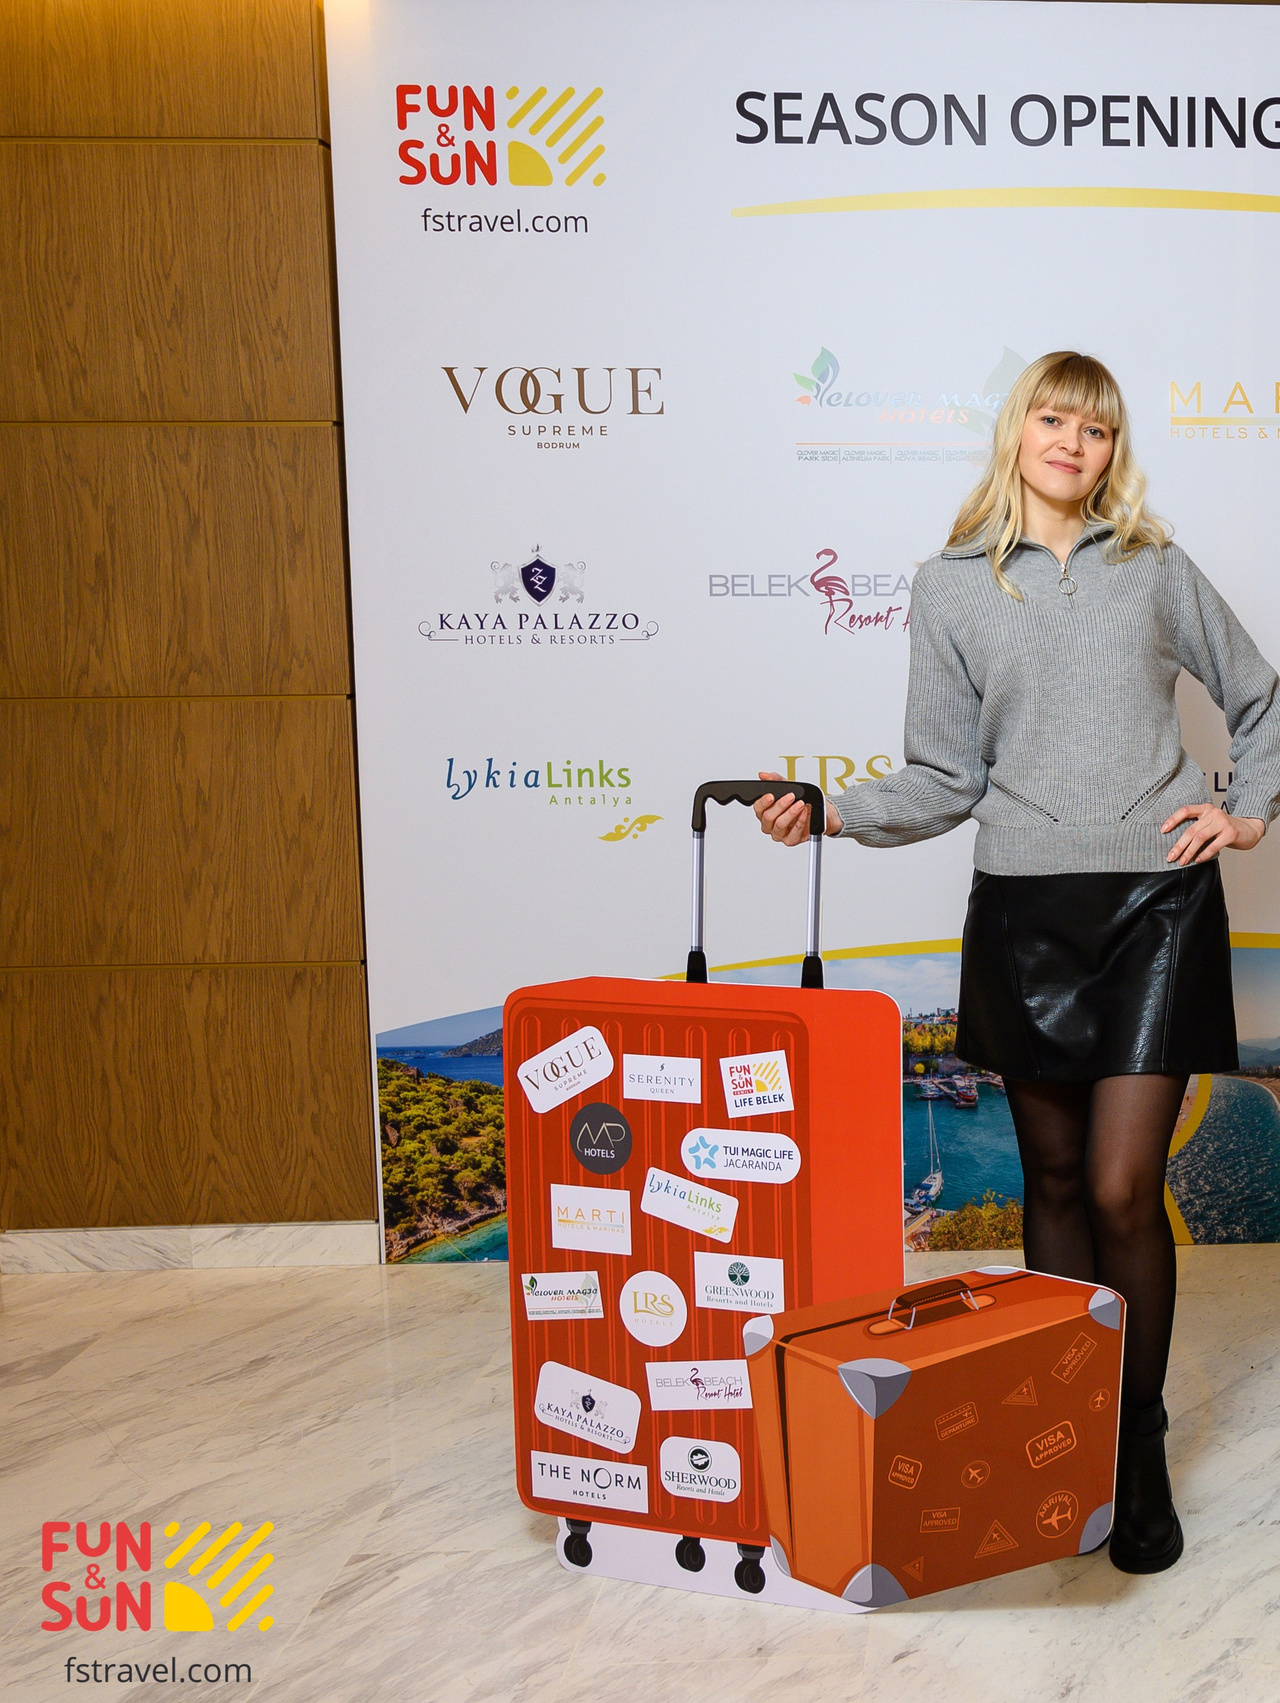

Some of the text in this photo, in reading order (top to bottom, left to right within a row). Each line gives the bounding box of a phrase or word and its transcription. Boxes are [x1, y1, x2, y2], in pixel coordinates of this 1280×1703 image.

[395, 85, 496, 131] FUN
[735, 92, 987, 145] SEASON
[436, 123, 456, 147] &
[398, 140, 497, 186] SUN
[421, 208, 588, 233] fstravel.com
[441, 366, 664, 415] VOGUE
[826, 392, 922, 407] CLOVER
[879, 408, 970, 424] HOTELS
[507, 425, 608, 436] SUPREME
[1170, 427, 1248, 439] HOTELS
[1258, 427, 1268, 439] &
[709, 574, 811, 597] BELEK
[439, 613, 640, 630] KAYA PALAZZO
[820, 598, 902, 635] Resort
[464, 634, 615, 645] HOTELS & RESORTS
[549, 794, 632, 807] Antalya
[524, 1036, 602, 1091] VOGUE
[729, 1064, 752, 1077] FUN
[554, 1069, 588, 1092] SUPREME
[629, 1074, 696, 1087] SERENITY
[650, 1087, 675, 1095] QUEEN
[734, 1093, 785, 1108] LIFE BELEK
[584, 1147, 615, 1159] HOTELS
[723, 1145, 794, 1161] TUI MAGIC LIFE
[723, 1158, 782, 1171] JACARANDA
[557, 1205, 625, 1224] MARTI
[686, 1204, 720, 1221] Antalya
[592, 1226, 625, 1234] MARINAS
[566, 1288, 598, 1296] MAGIC
[704, 1284, 775, 1301] GREENWOOD
[631, 1290, 675, 1318] LRS
[706, 1295, 773, 1308] Resorts and Hotels
[634, 1317, 673, 1327] HOTELS
[1062, 1348, 1078, 1365] VISA
[1063, 1341, 1091, 1378] APPROVED
[656, 1376, 743, 1388] BELEK BEACH
[547, 1402, 624, 1439] KAYA PALAZZO
[555, 1415, 578, 1428] HOTELS
[587, 1427, 613, 1441] RESORTS
[940, 1418, 976, 1438] DEPARTURE
[1035, 1430, 1065, 1450] VISA
[1034, 1438, 1072, 1463] APPROVED
[537, 1462, 642, 1491] THE NORM
[898, 1461, 915, 1476] VISA
[664, 1470, 737, 1490] SHERWOOD
[892, 1472, 915, 1484] APPROVED
[572, 1489, 607, 1500] HOTELS
[676, 1483, 725, 1496] Resorts and Hotels
[1039, 1494, 1073, 1518] ARRIVAL
[923, 1518, 957, 1527] APPROVED
